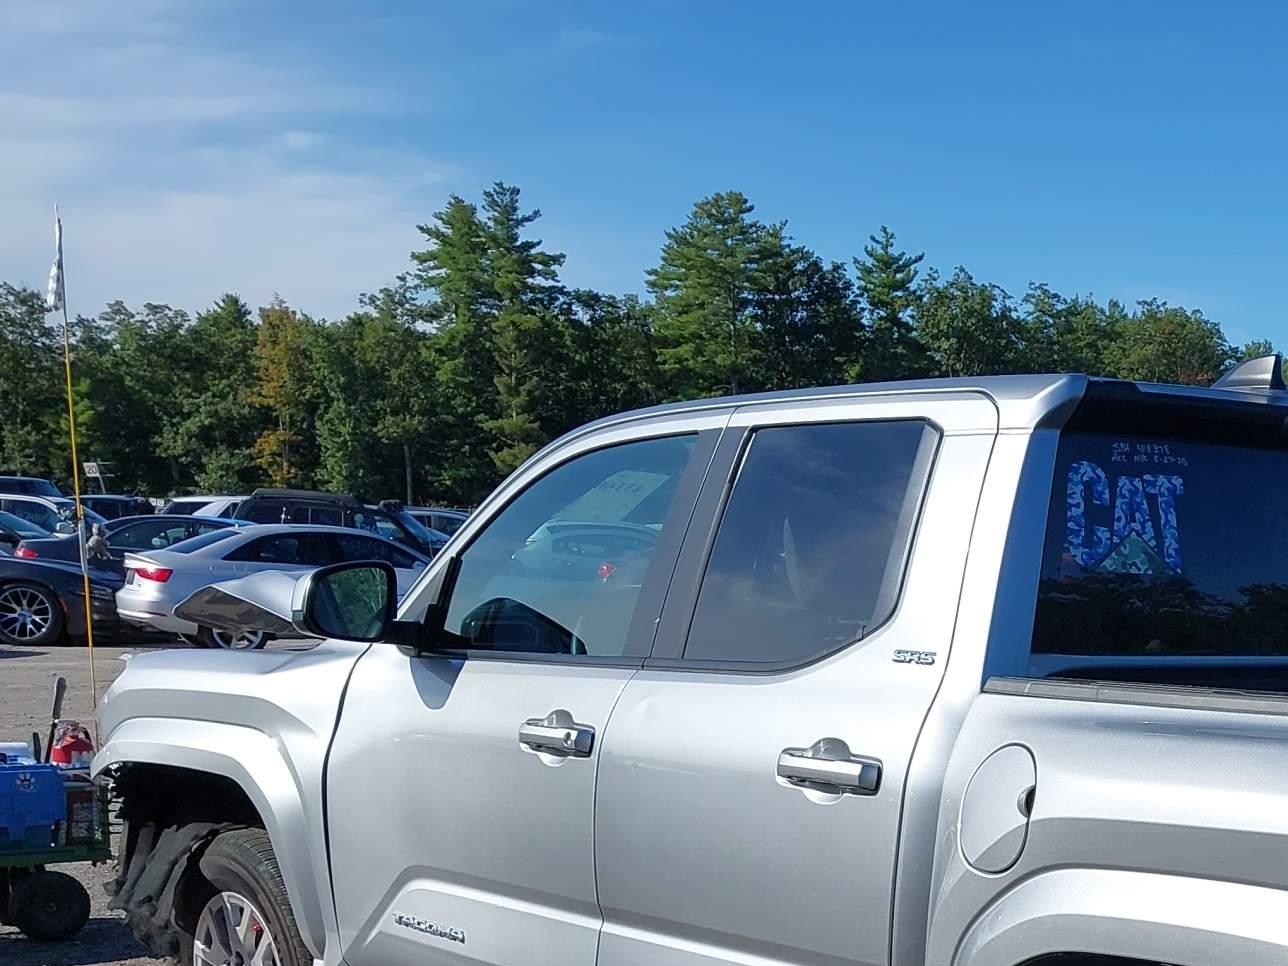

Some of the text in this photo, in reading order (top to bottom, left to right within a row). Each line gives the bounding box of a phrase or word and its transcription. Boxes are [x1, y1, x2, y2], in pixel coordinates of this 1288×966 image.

[86, 465, 98, 474] 20
[1065, 461, 1184, 574] CAT
[892, 649, 937, 666] SR5
[392, 912, 466, 944] TACOMA
